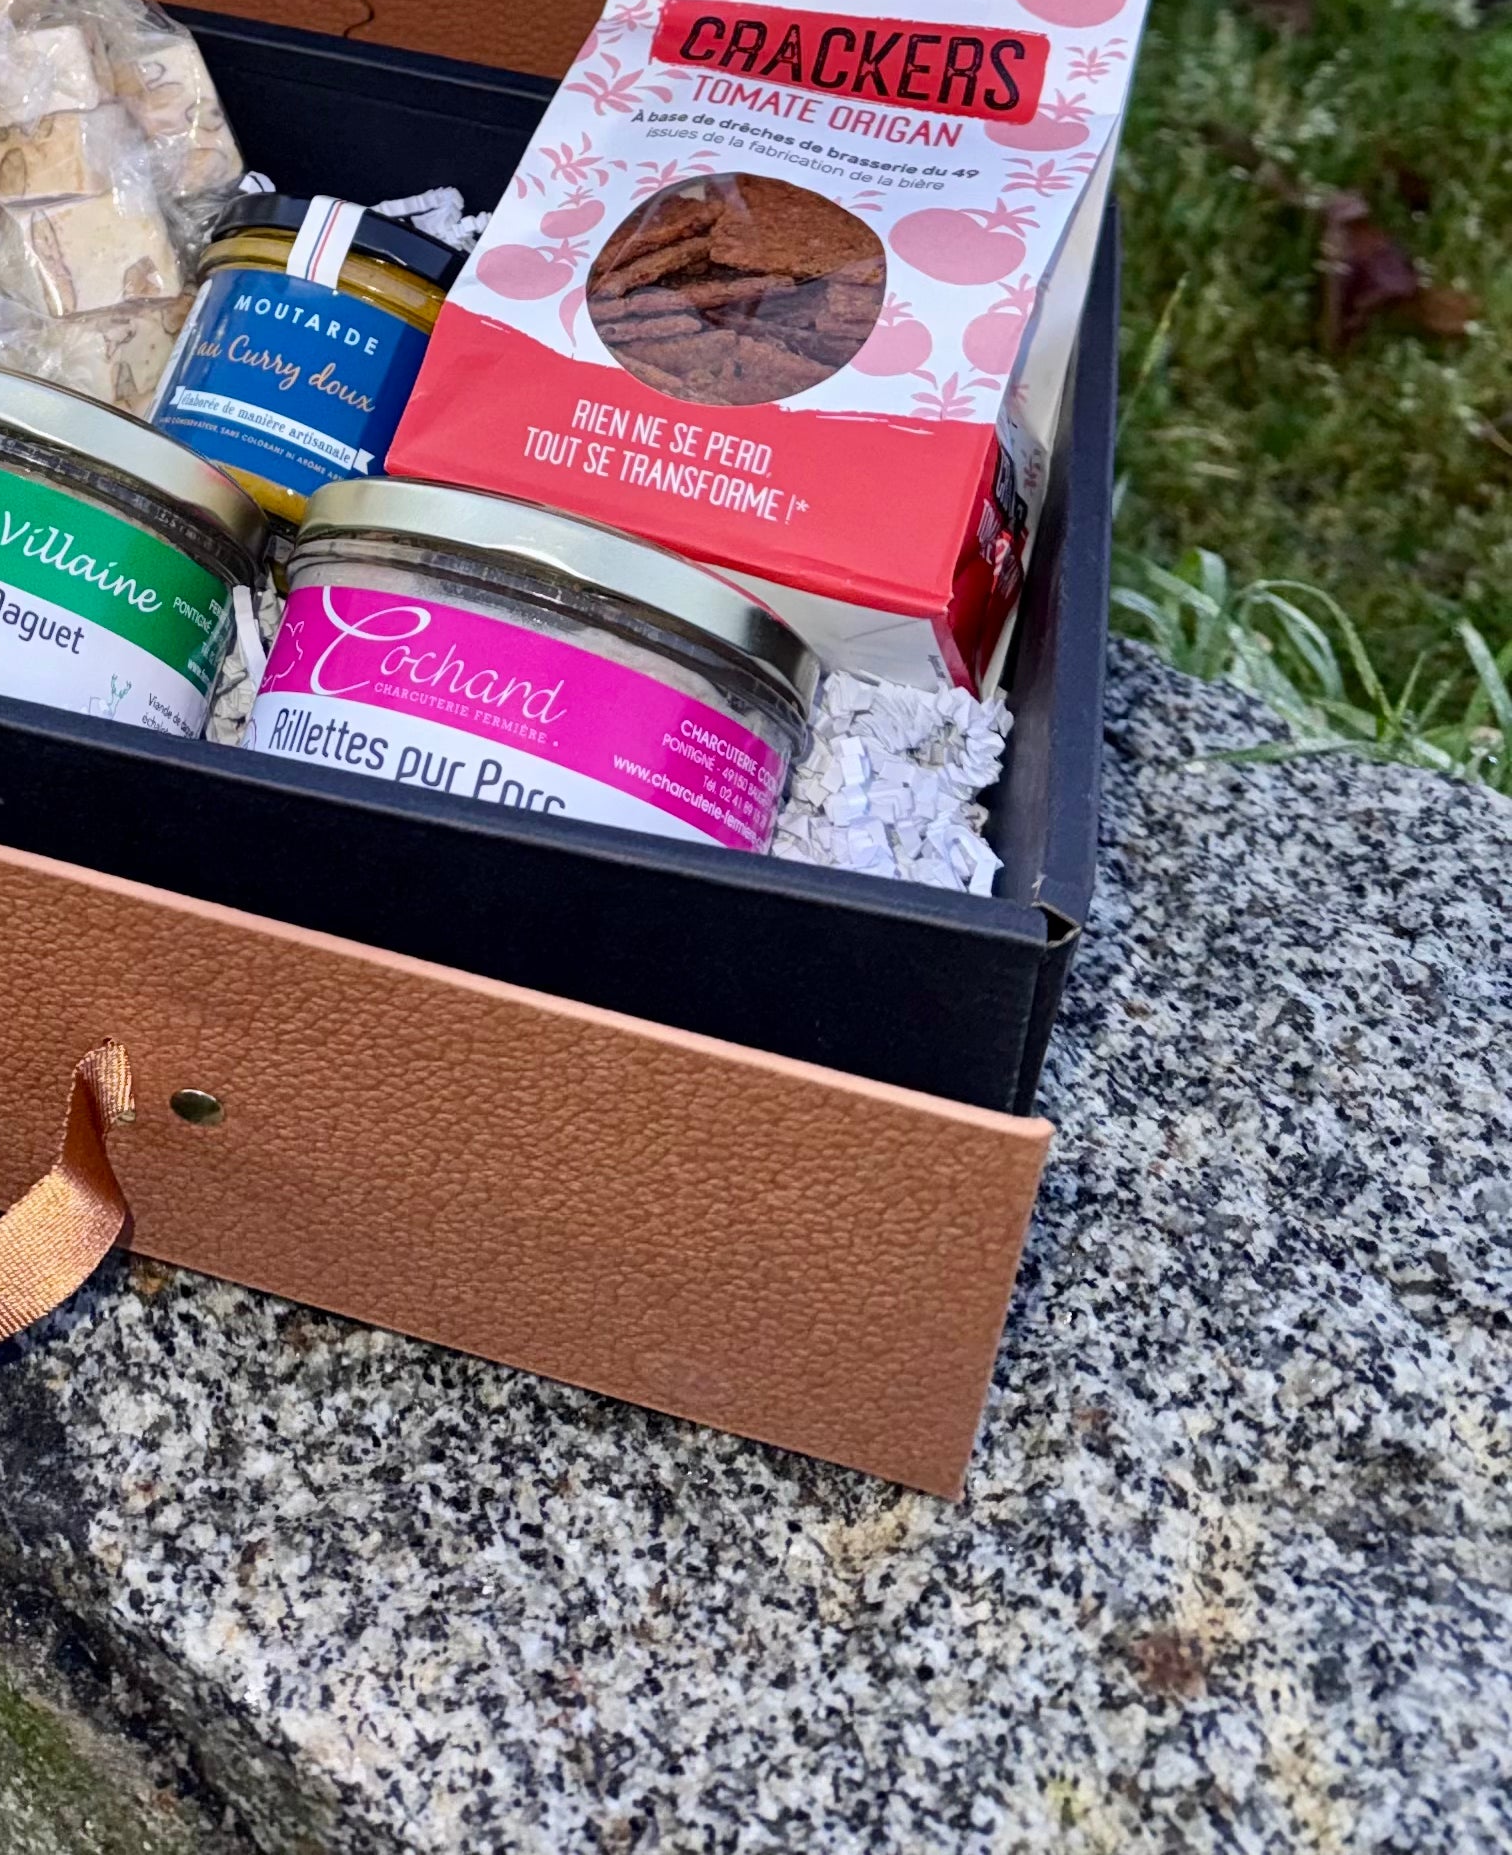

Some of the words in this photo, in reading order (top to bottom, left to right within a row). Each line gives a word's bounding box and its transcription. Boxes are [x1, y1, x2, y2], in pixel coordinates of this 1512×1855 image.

[679, 16, 1026, 112] CRACKERS
[631, 109, 646, 124] À
[647, 111, 689, 125] base
[692, 112, 714, 128] de
[719, 115, 795, 147] drêches
[799, 138, 823, 155] de
[827, 145, 917, 176] brasserie
[922, 162, 949, 179] du
[953, 167, 980, 180] 49
[692, 74, 823, 124] TOMATE
[828, 106, 963, 148] ORIGAN
[645, 125, 699, 141] issues
[702, 128, 725, 145] de
[728, 133, 745, 149] la
[747, 138, 844, 178] fabrication
[850, 168, 874, 186] de
[877, 173, 894, 189] la
[898, 174, 945, 192] bière
[234, 295, 379, 356] MOUTARDE
[196, 341, 223, 358] au
[228, 334, 301, 391] Curry
[308, 362, 376, 413] doux
[222, 401, 236, 415] de
[237, 408, 287, 433] manière
[289, 426, 351, 465] artisanale
[571, 399, 630, 440] RIEN
[631, 413, 667, 448] NE
[669, 423, 702, 457] SE
[704, 431, 773, 478] PERD,
[524, 426, 582, 468] TOUT
[583, 443, 616, 477] SE
[619, 450, 784, 522] TRANSFORME
[0, 510, 163, 613] Villaine
[310, 585, 567, 724] Cochard
[374, 681, 470, 718] CHARCUTERIE
[474, 710, 547, 745] FERMIÈRE
[680, 719, 759, 777] CHARCUTERIE
[268, 708, 389, 771] Rillettes
[395, 746, 466, 793] pur
[662, 733, 716, 772] PONTIGNÉ
[719, 785, 733, 803] 02
